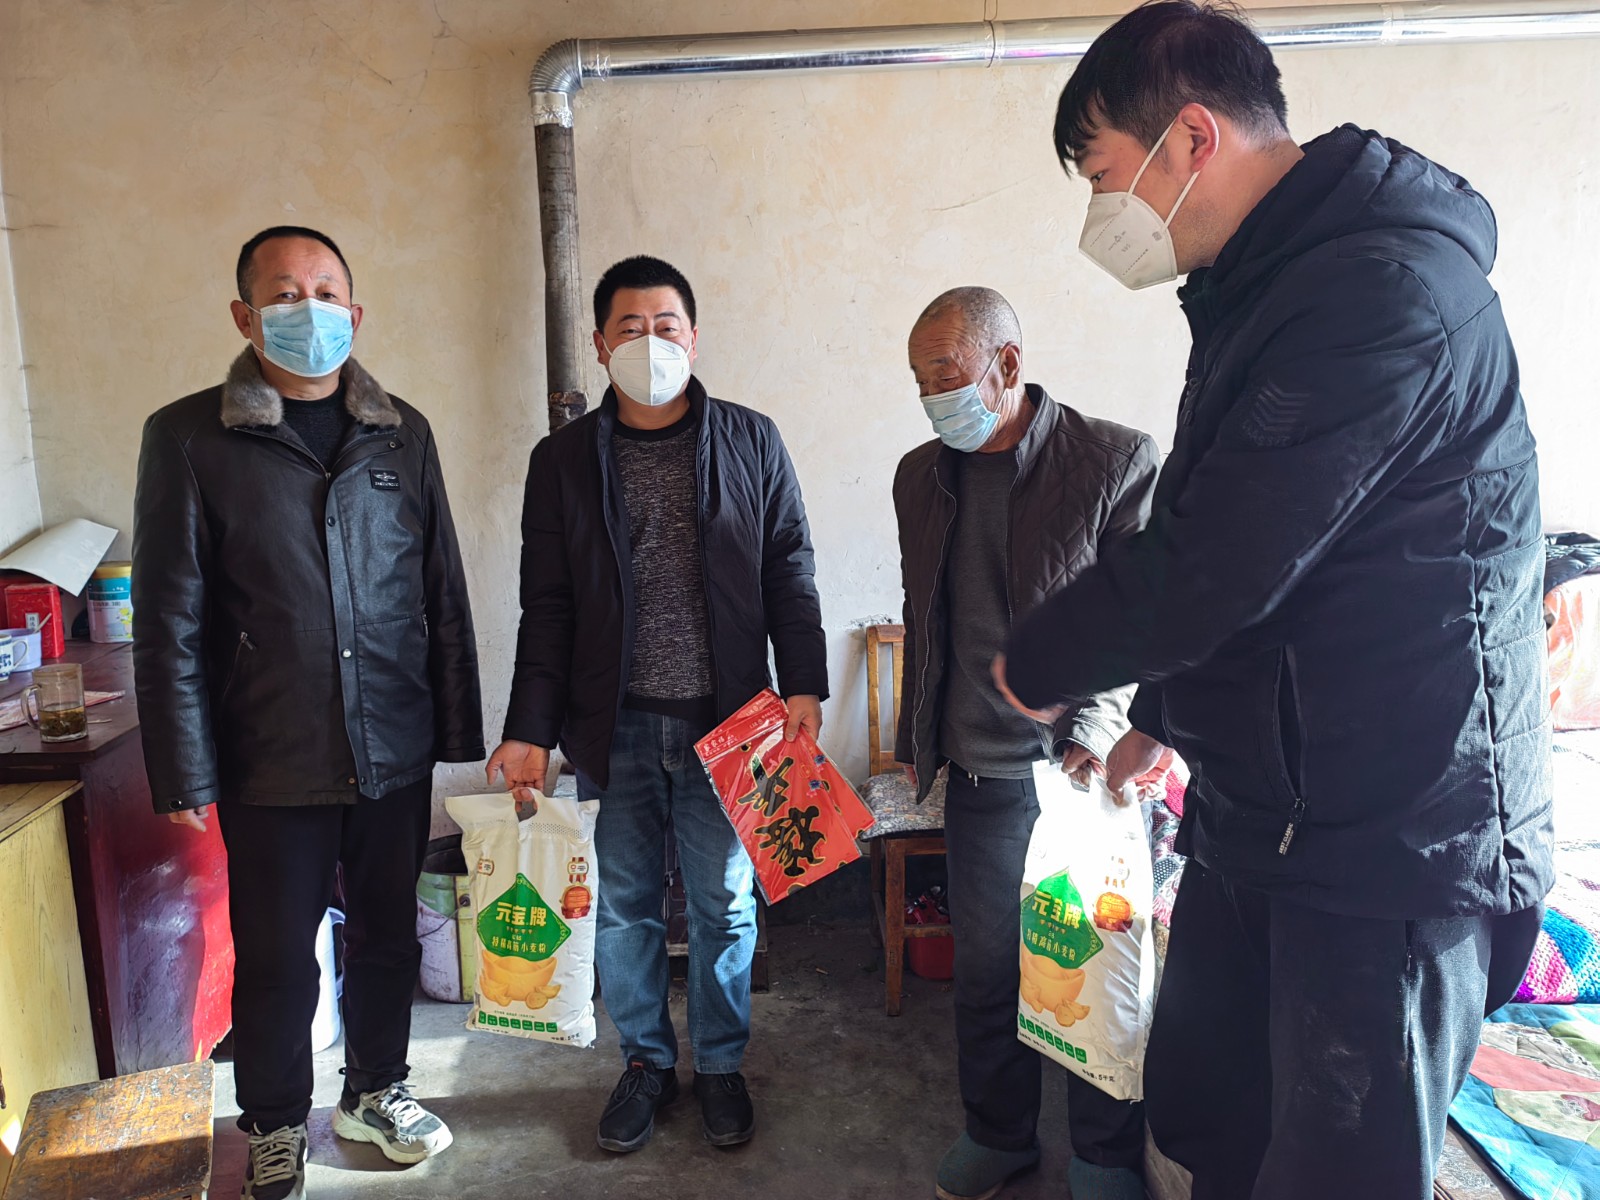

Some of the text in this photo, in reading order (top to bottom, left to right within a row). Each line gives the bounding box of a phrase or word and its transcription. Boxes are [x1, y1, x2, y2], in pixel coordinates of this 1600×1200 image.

[495, 901, 547, 927] 元宝牌
[1031, 890, 1083, 930] 元宝牌
